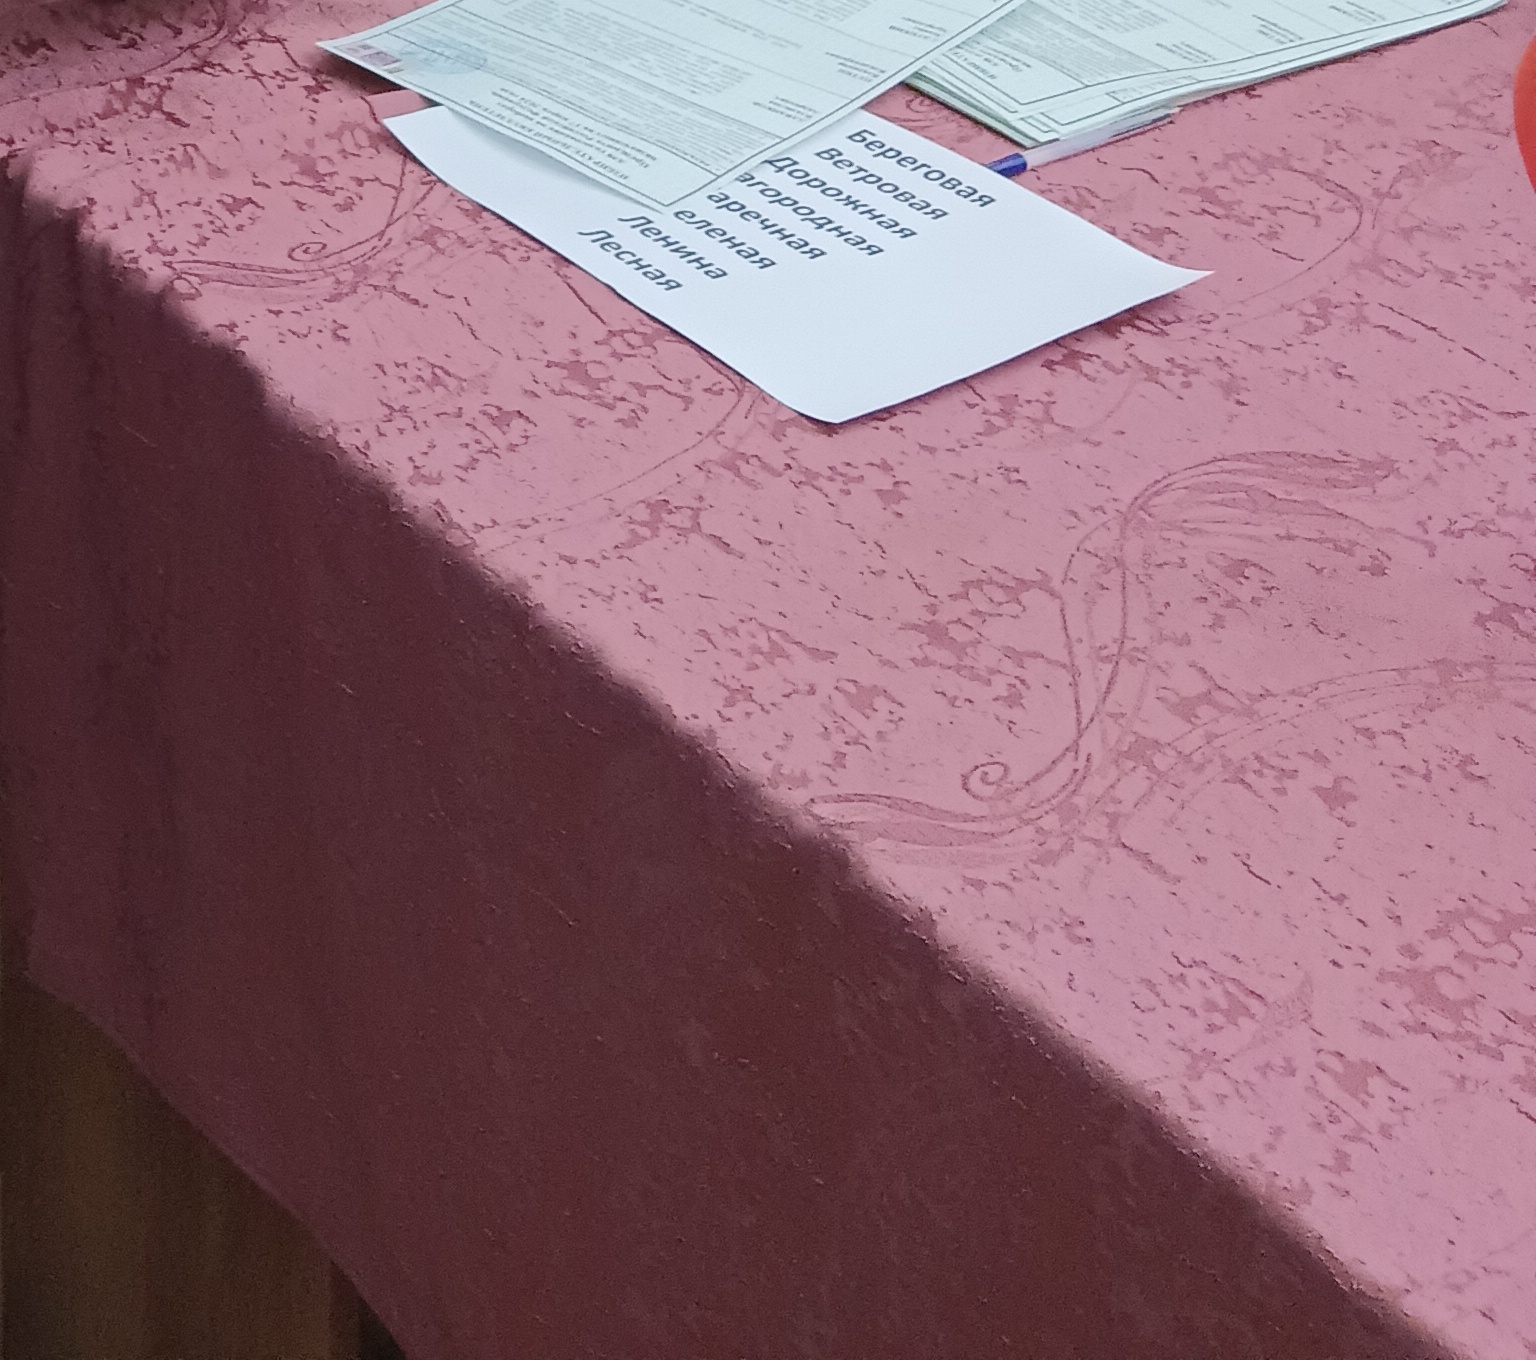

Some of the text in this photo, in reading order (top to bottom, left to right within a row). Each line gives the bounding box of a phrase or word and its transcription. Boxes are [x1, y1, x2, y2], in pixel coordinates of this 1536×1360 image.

[762, 156, 919, 240] Дорожная
[814, 147, 949, 221] Ветровая
[845, 128, 998, 208] Береговая
[617, 215, 729, 281] Ленина
[672, 208, 778, 270] еленая
[706, 191, 828, 261] аречная
[733, 171, 886, 257] агородная
[577, 229, 684, 292] Лесная
